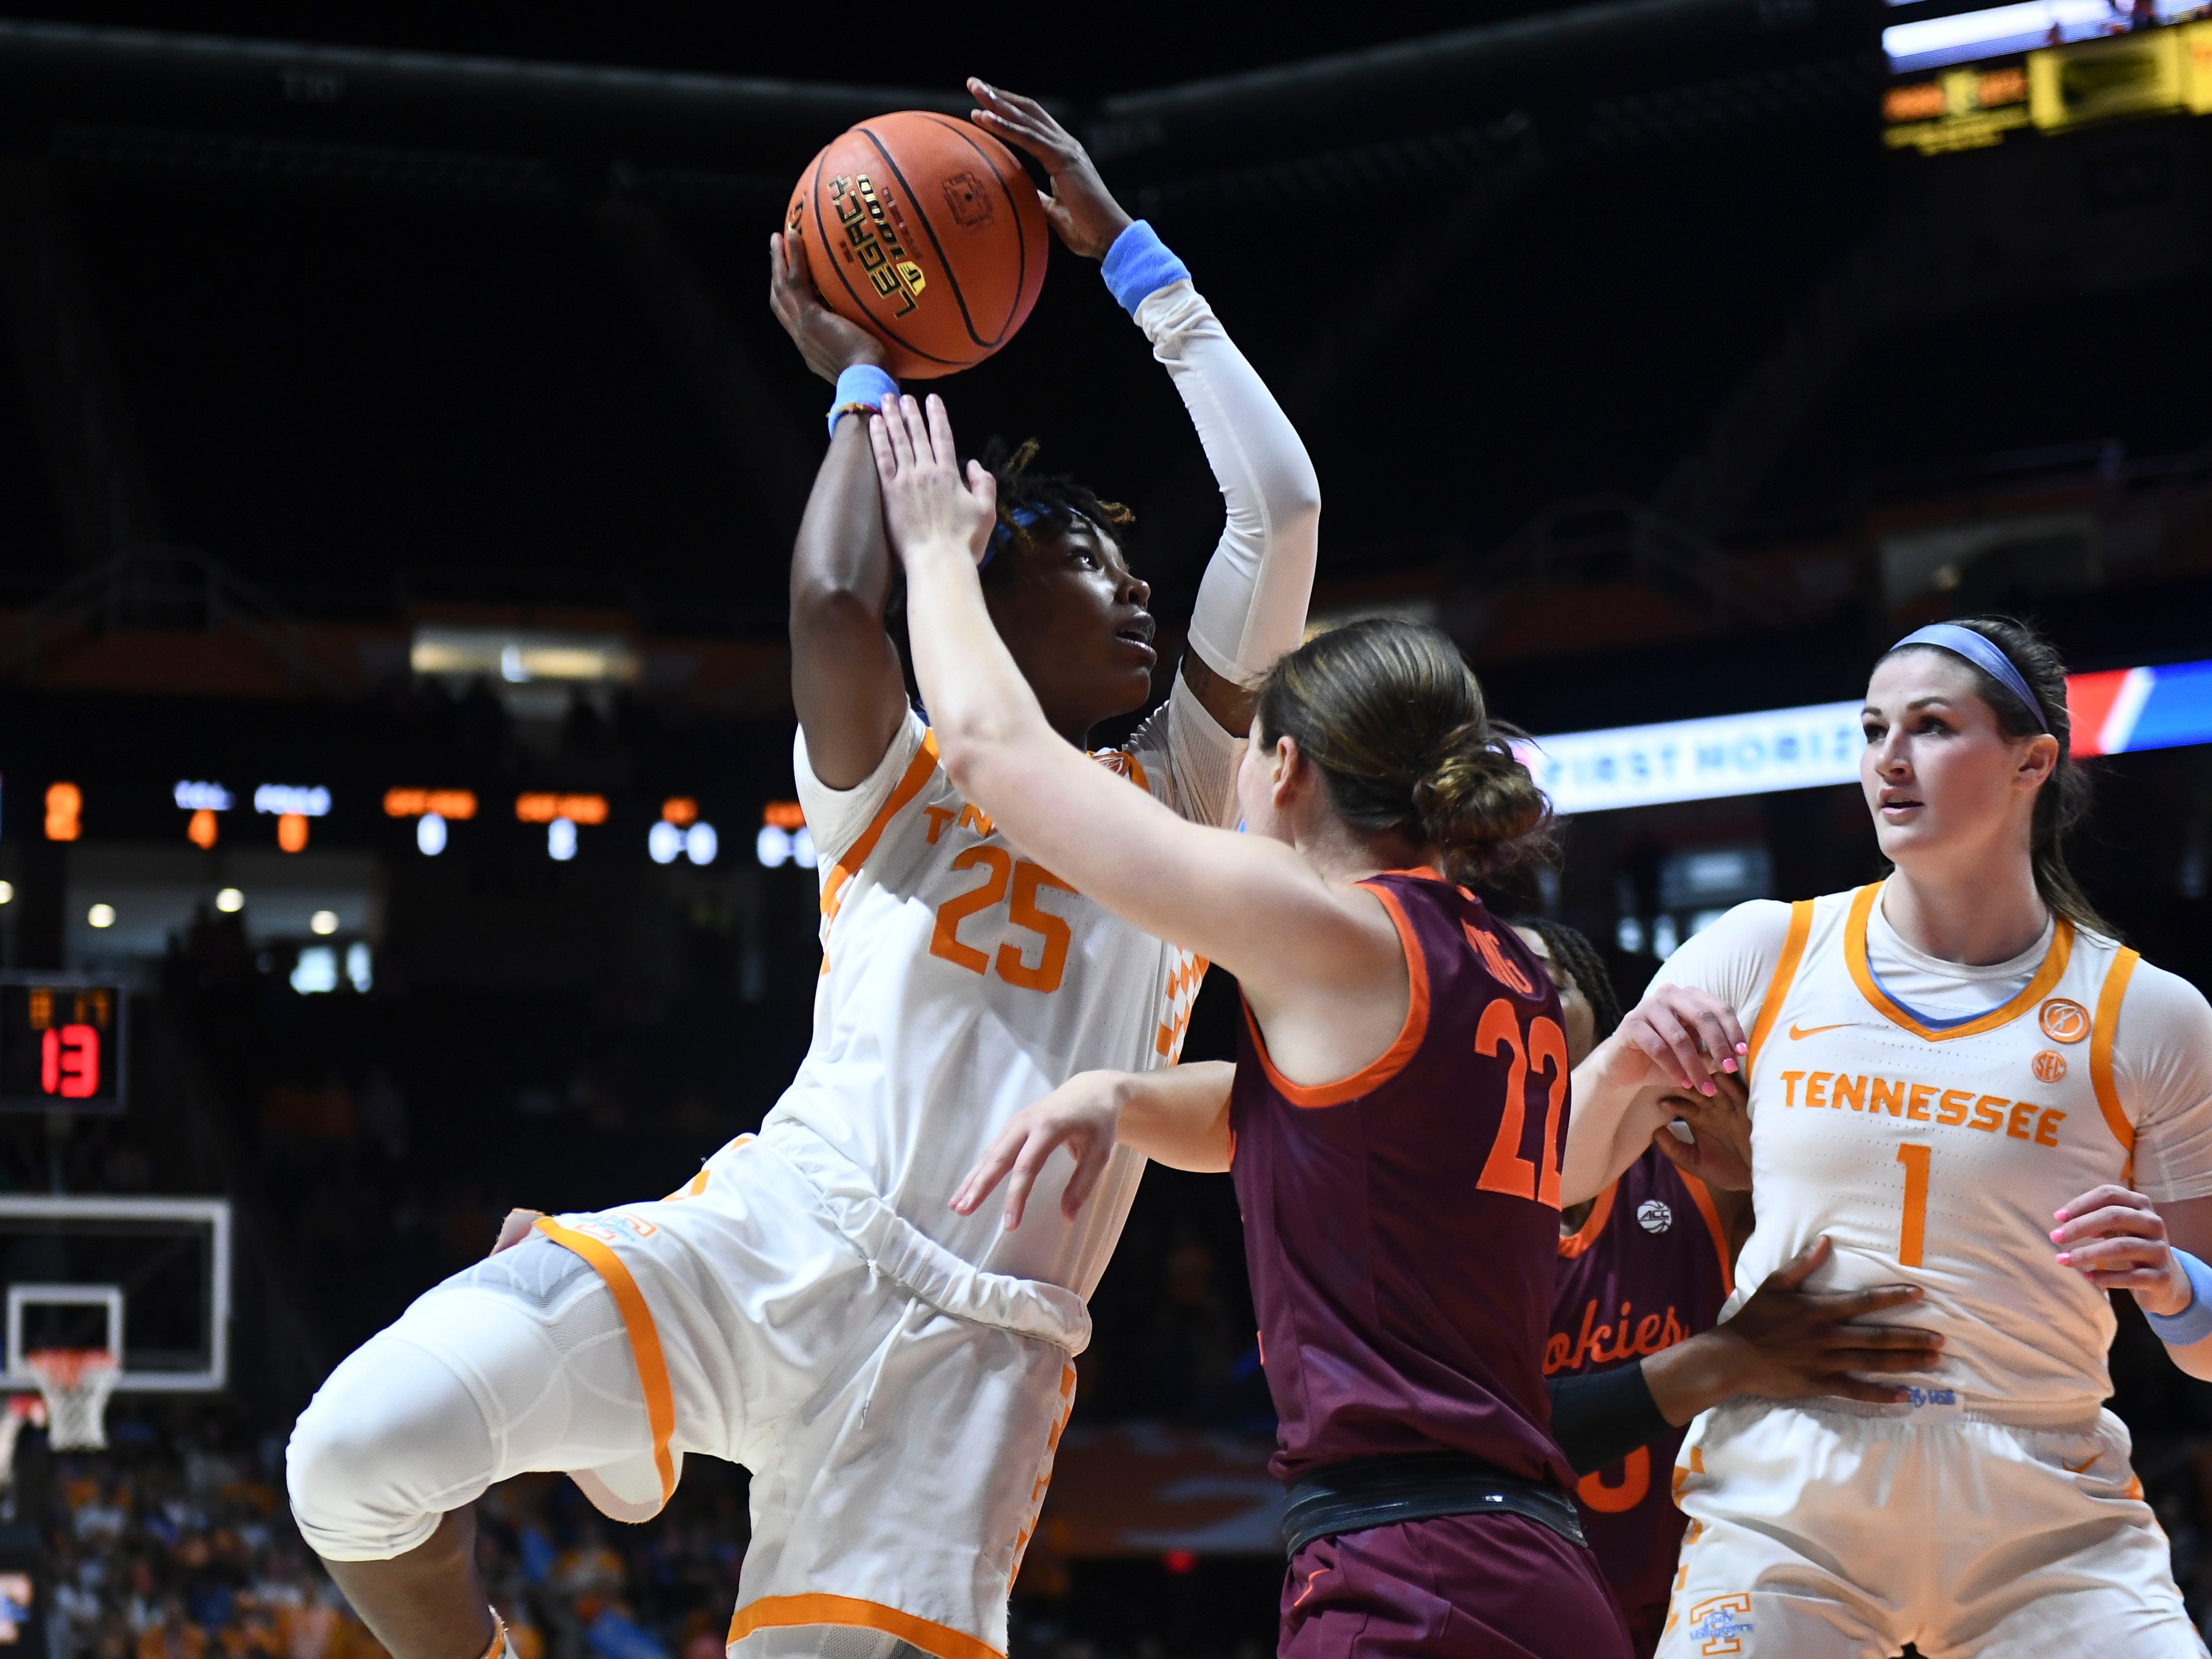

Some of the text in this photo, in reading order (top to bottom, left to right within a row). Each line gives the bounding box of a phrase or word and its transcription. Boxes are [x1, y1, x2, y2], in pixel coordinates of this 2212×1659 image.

[828, 174, 918, 319] LEGACY
[1545, 726, 1854, 786] FIRST HORIZ
[928, 844, 1080, 995] 25
[41, 1024, 100, 1098] 13
[1474, 999, 1567, 1212] 22
[1779, 1070, 2069, 1148] TENNESSEE
[1638, 1209, 1670, 1222] ACC
[1896, 1142, 1932, 1267] 1
[1542, 1299, 1691, 1376] okies
